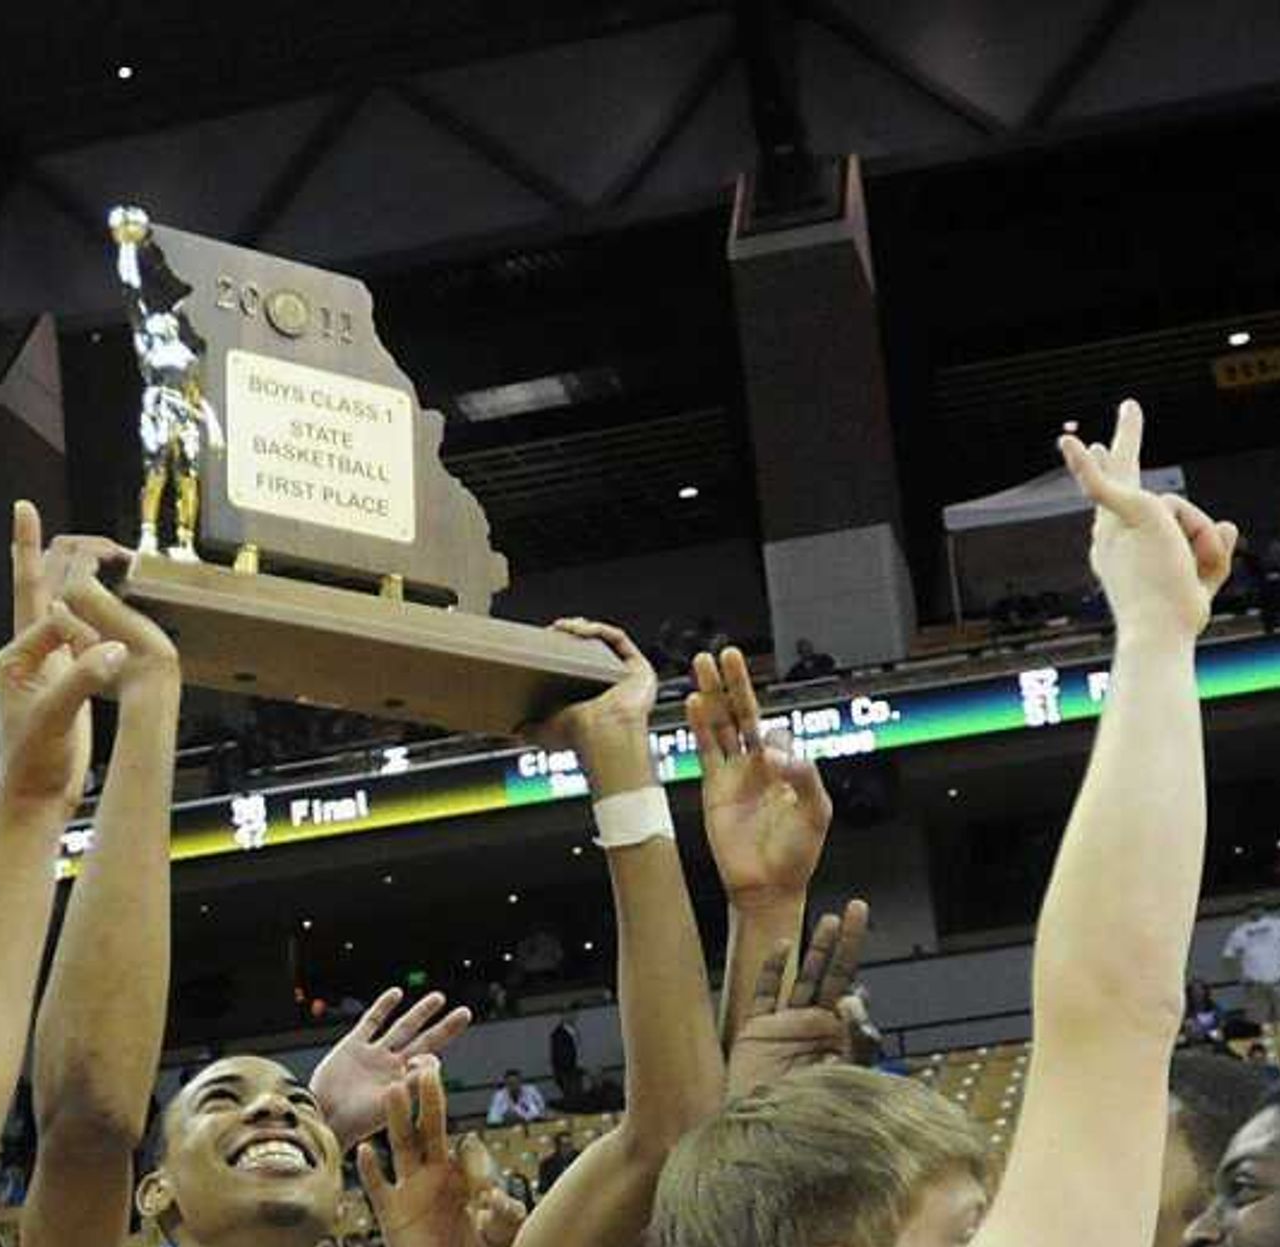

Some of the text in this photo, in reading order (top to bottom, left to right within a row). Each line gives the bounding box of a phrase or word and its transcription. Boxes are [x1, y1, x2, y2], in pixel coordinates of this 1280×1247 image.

[249, 374, 394, 425] BOYS CLASS 1
[290, 420, 354, 448] STATE
[252, 435, 391, 483] BASKETBALL
[256, 471, 391, 517] FIRST PLACE
[290, 789, 369, 827] Final
